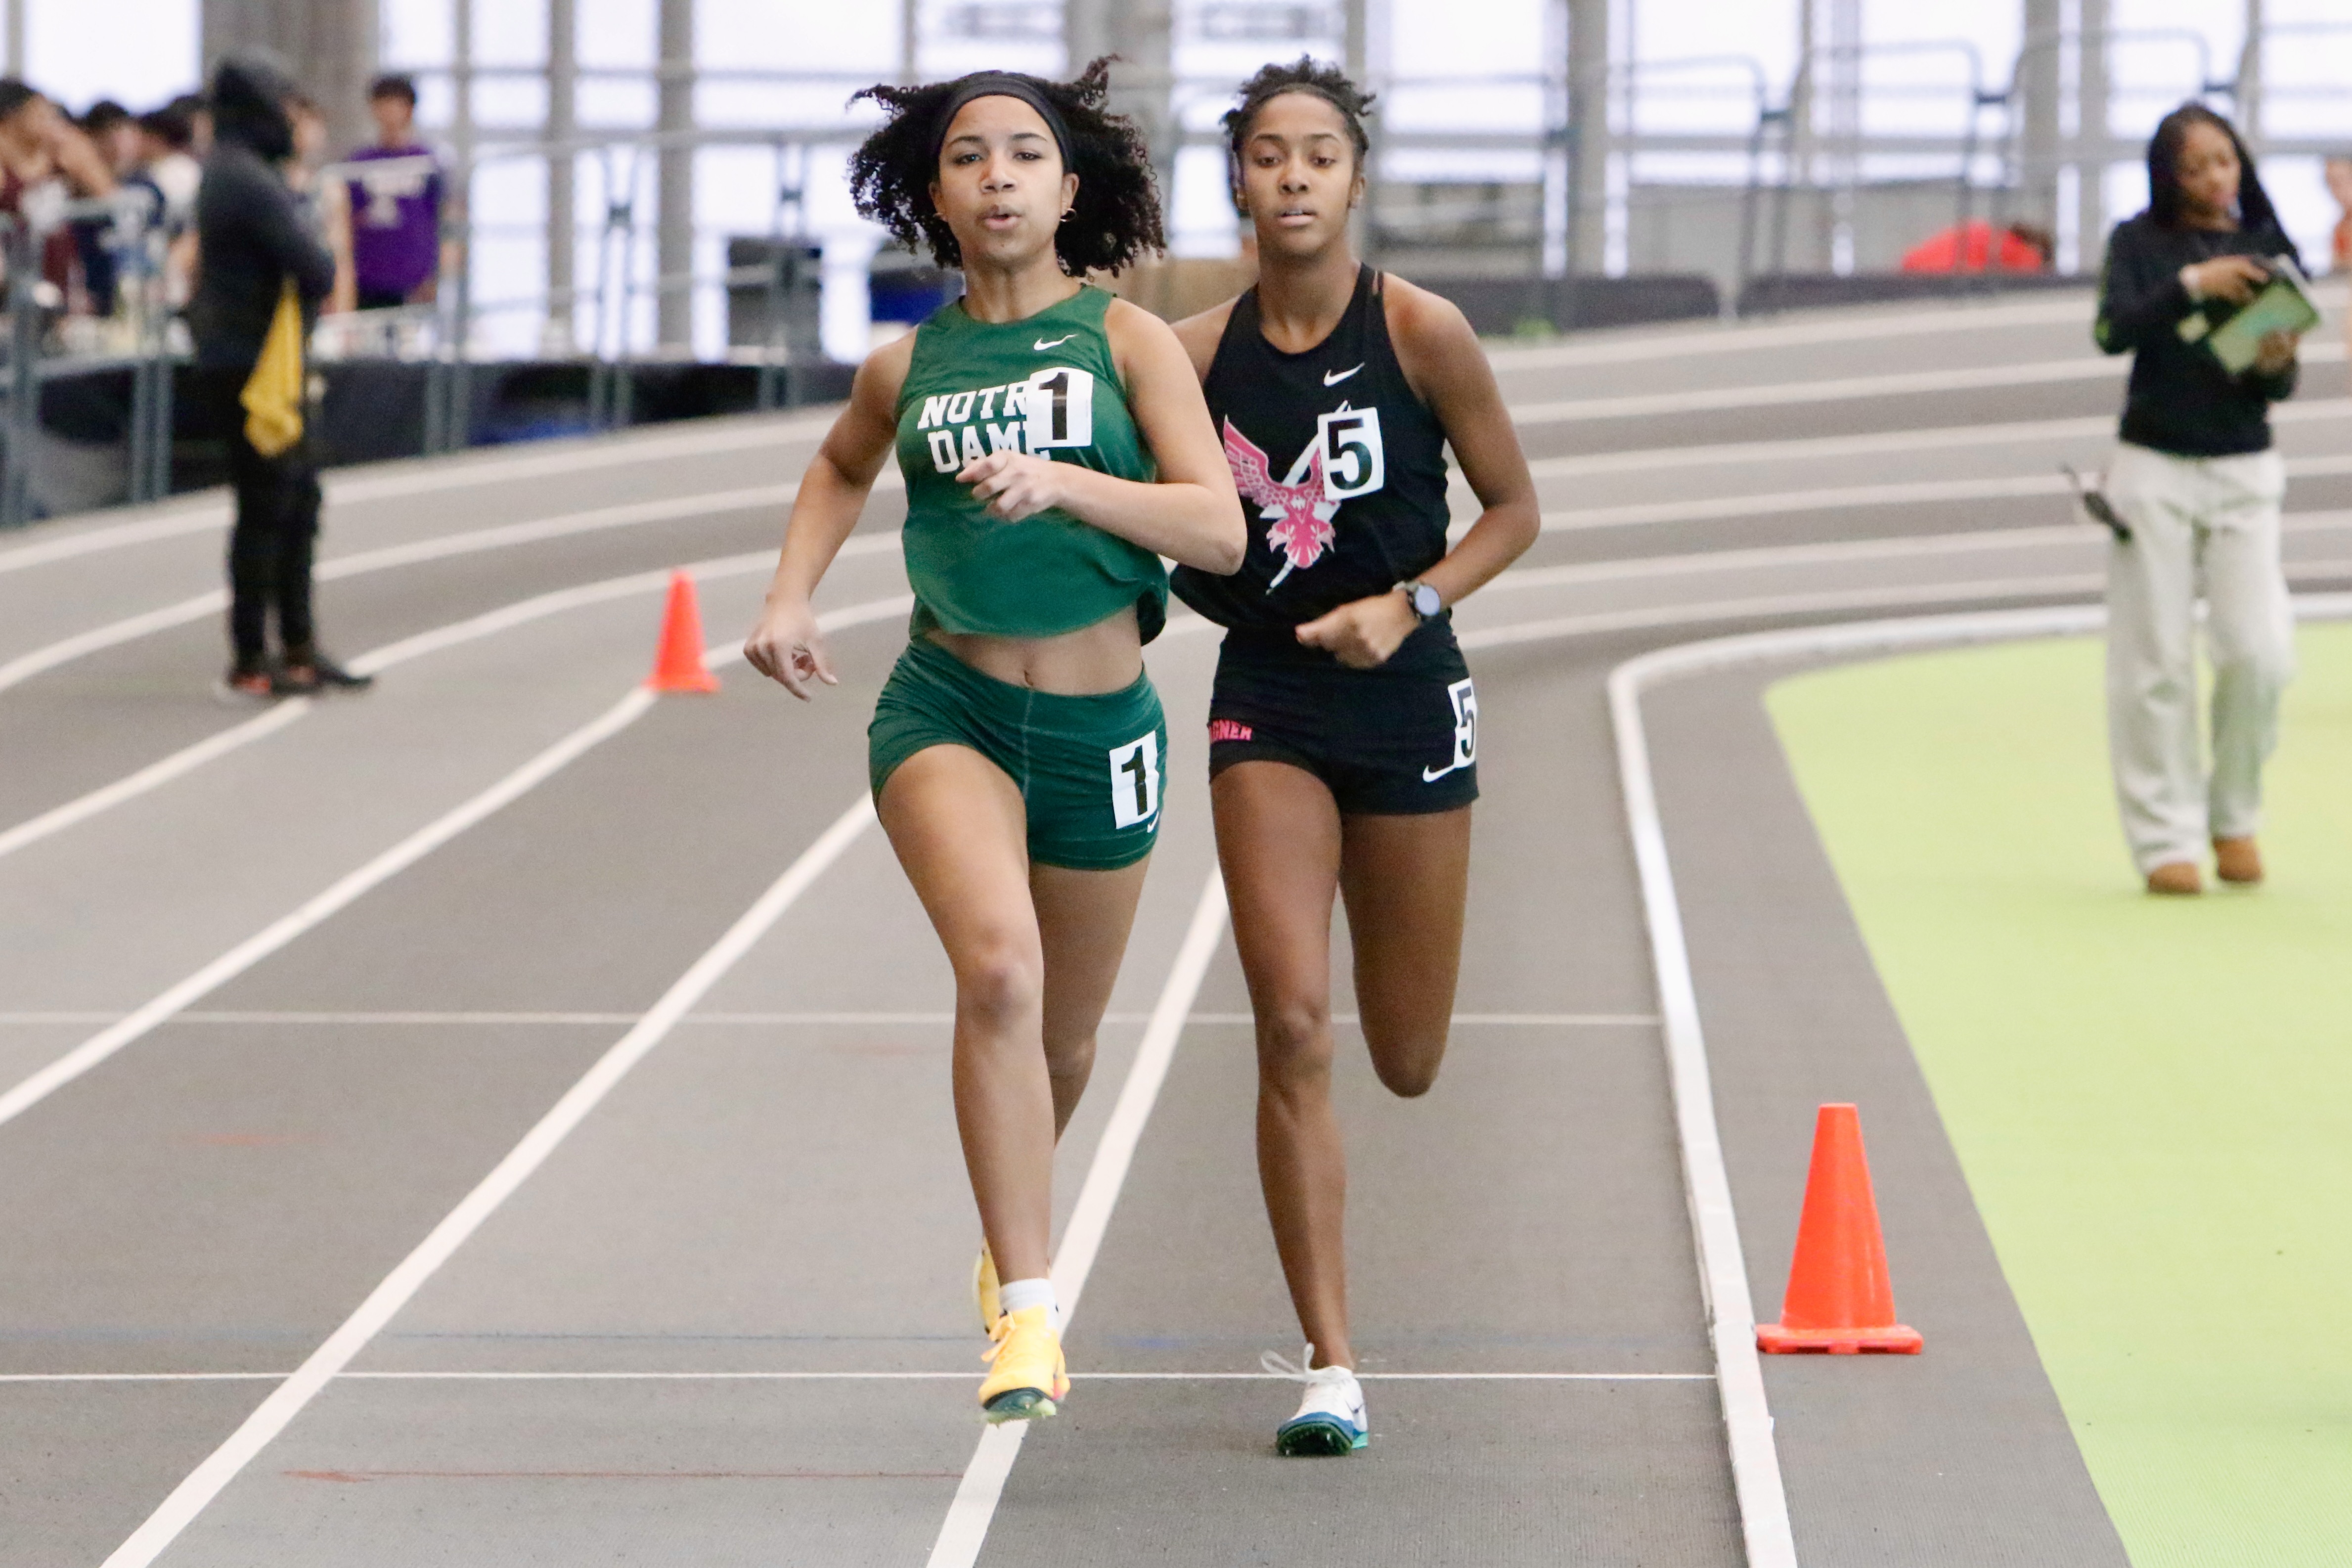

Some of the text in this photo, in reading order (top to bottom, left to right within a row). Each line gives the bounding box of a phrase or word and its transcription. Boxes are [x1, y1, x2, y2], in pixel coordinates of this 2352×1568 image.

[917, 380, 1030, 430] NOTR
[1038, 372, 1069, 441] 1
[1328, 417, 1372, 491] 5
[1208, 719, 1252, 744] GNER
[1457, 686, 1474, 758] 5
[1121, 745, 1148, 816] 1
